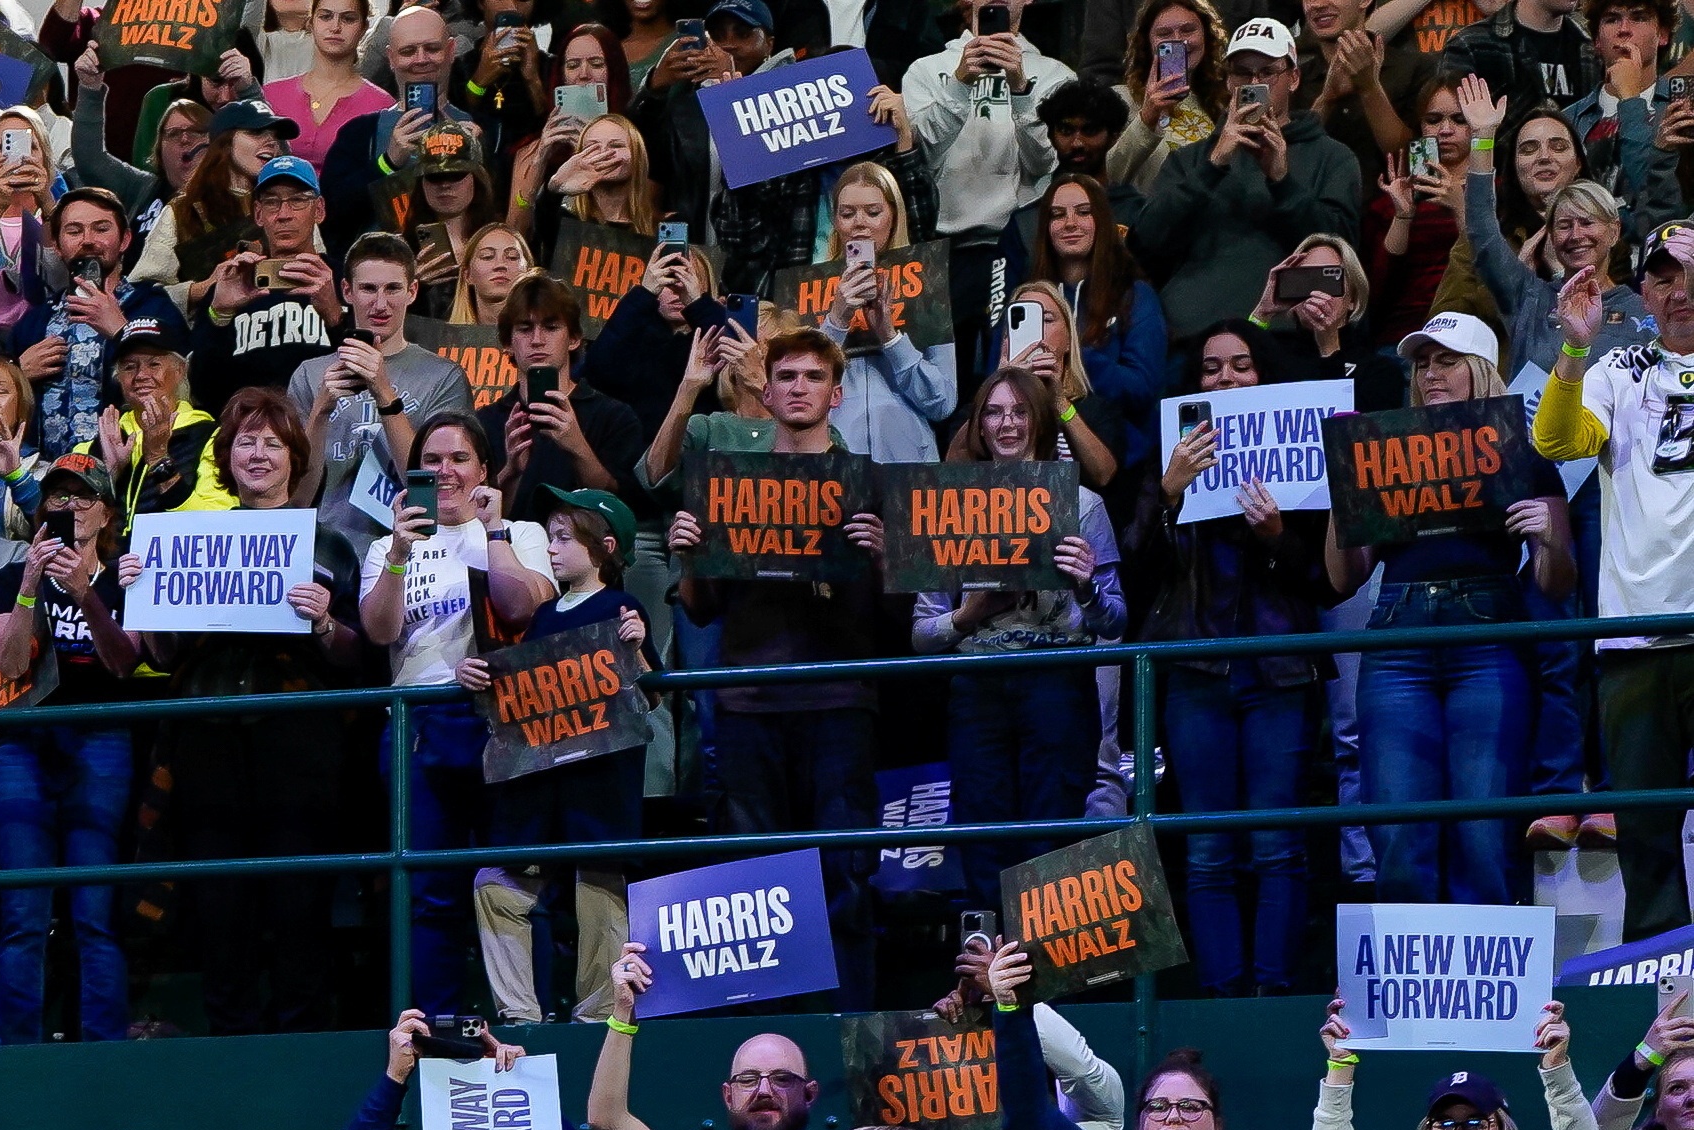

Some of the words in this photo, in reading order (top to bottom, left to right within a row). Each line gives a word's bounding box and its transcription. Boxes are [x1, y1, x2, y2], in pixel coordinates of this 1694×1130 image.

[119, 23, 197, 50] WALZ
[1236, 23, 1274, 42] USA
[731, 73, 853, 135] HARRIS
[761, 110, 845, 152] WALZ
[573, 246, 646, 294] HAR
[797, 262, 923, 320] HAIS
[233, 302, 330, 357] DETRO
[1354, 427, 1501, 488] HARRIS
[709, 477, 842, 527] HARRIS
[912, 485, 1050, 538] HARRIS
[1380, 478, 1483, 517] WALZ
[145, 536, 165, 567] A
[172, 534, 227, 568] NEW
[238, 533, 297, 568] WAY
[423, 548, 448, 559] ARE
[730, 528, 822, 556] WALZ
[932, 535, 1030, 567] WALZ
[154, 571, 283, 606] FORWARD
[406, 573, 436, 587] OING
[406, 593, 437, 607] ACK.
[443, 597, 477, 616] EVER
[494, 649, 619, 726] HARRIS
[521, 702, 609, 748] WALZ
[906, 781, 951, 868] HARIS
[658, 887, 793, 952] HARRIS
[1020, 860, 1142, 941] HARRIS
[682, 940, 779, 979] WALZ
[1041, 927, 1136, 968] WALZ
[1355, 935, 1377, 976] A
[1384, 935, 1453, 978] NEW
[1463, 935, 1534, 978] WAY
[1367, 979, 1518, 1021] FORWARD
[878, 1062, 999, 1125] ARRIS
